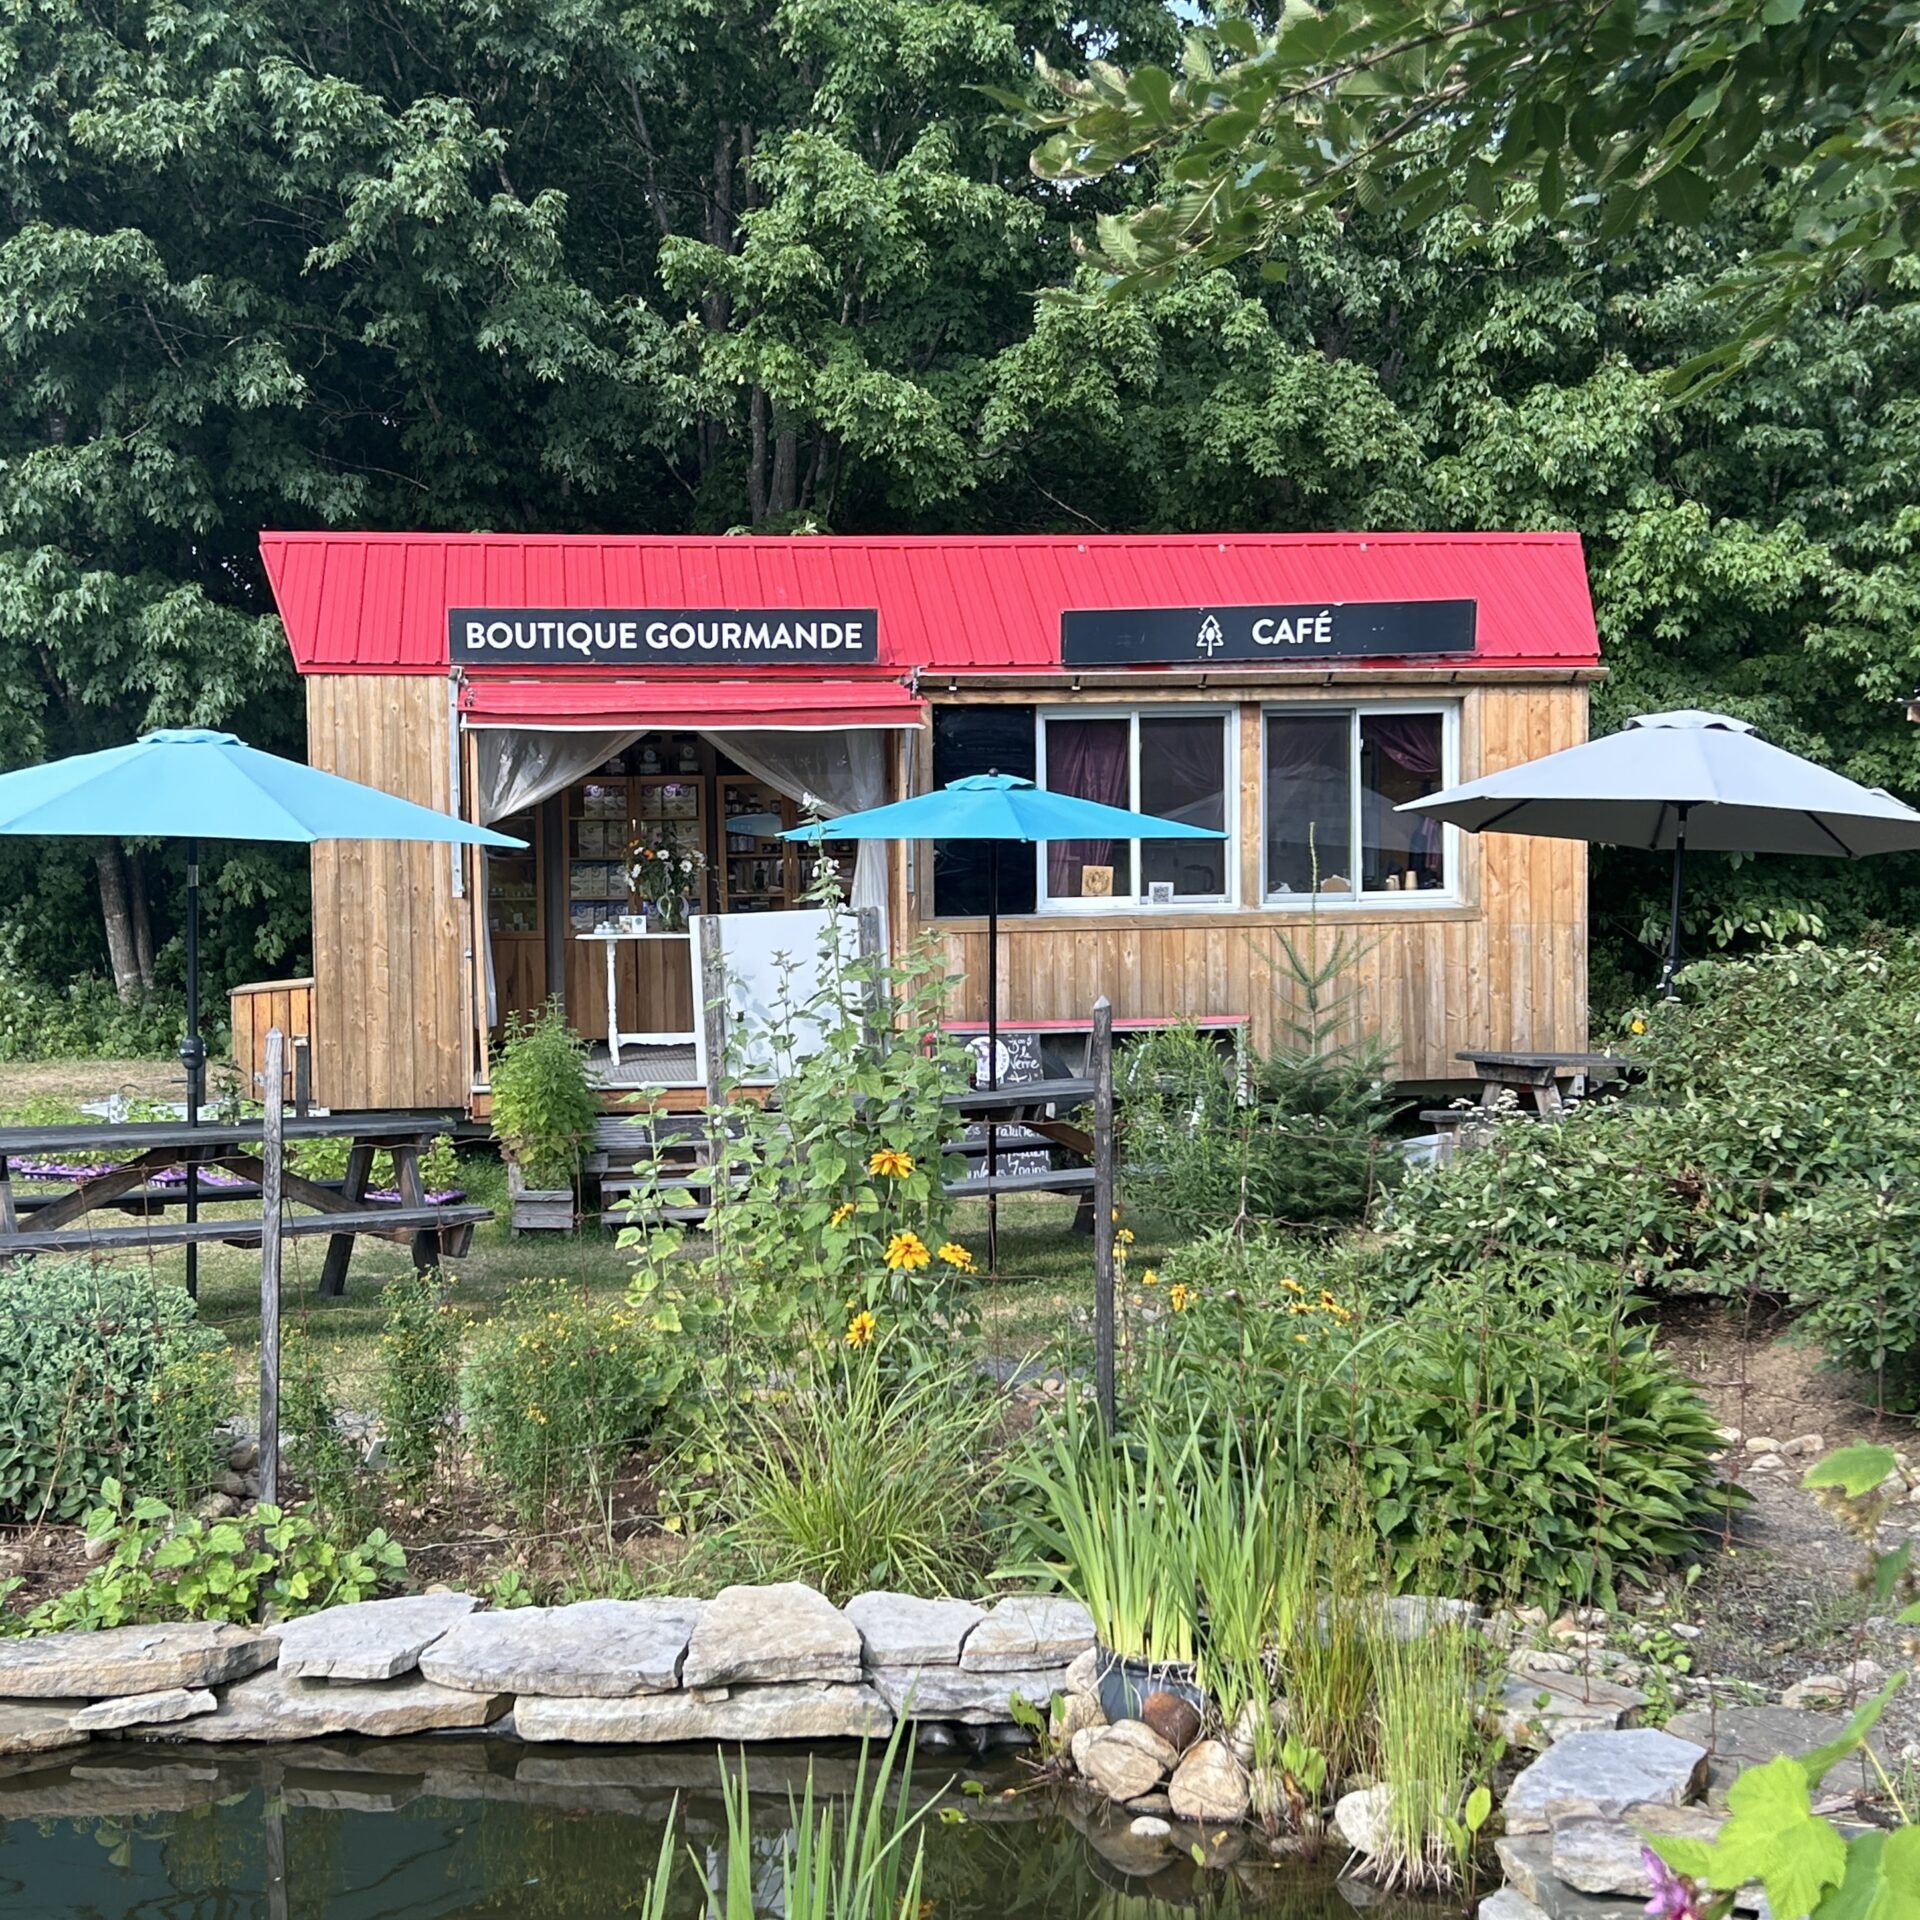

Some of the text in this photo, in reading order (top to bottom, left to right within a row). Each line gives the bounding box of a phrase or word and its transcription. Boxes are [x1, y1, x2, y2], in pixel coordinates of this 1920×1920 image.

[466, 621, 863, 655] BOUTIQUE GOURMANDE
[1252, 609, 1332, 645] CAFÉ
